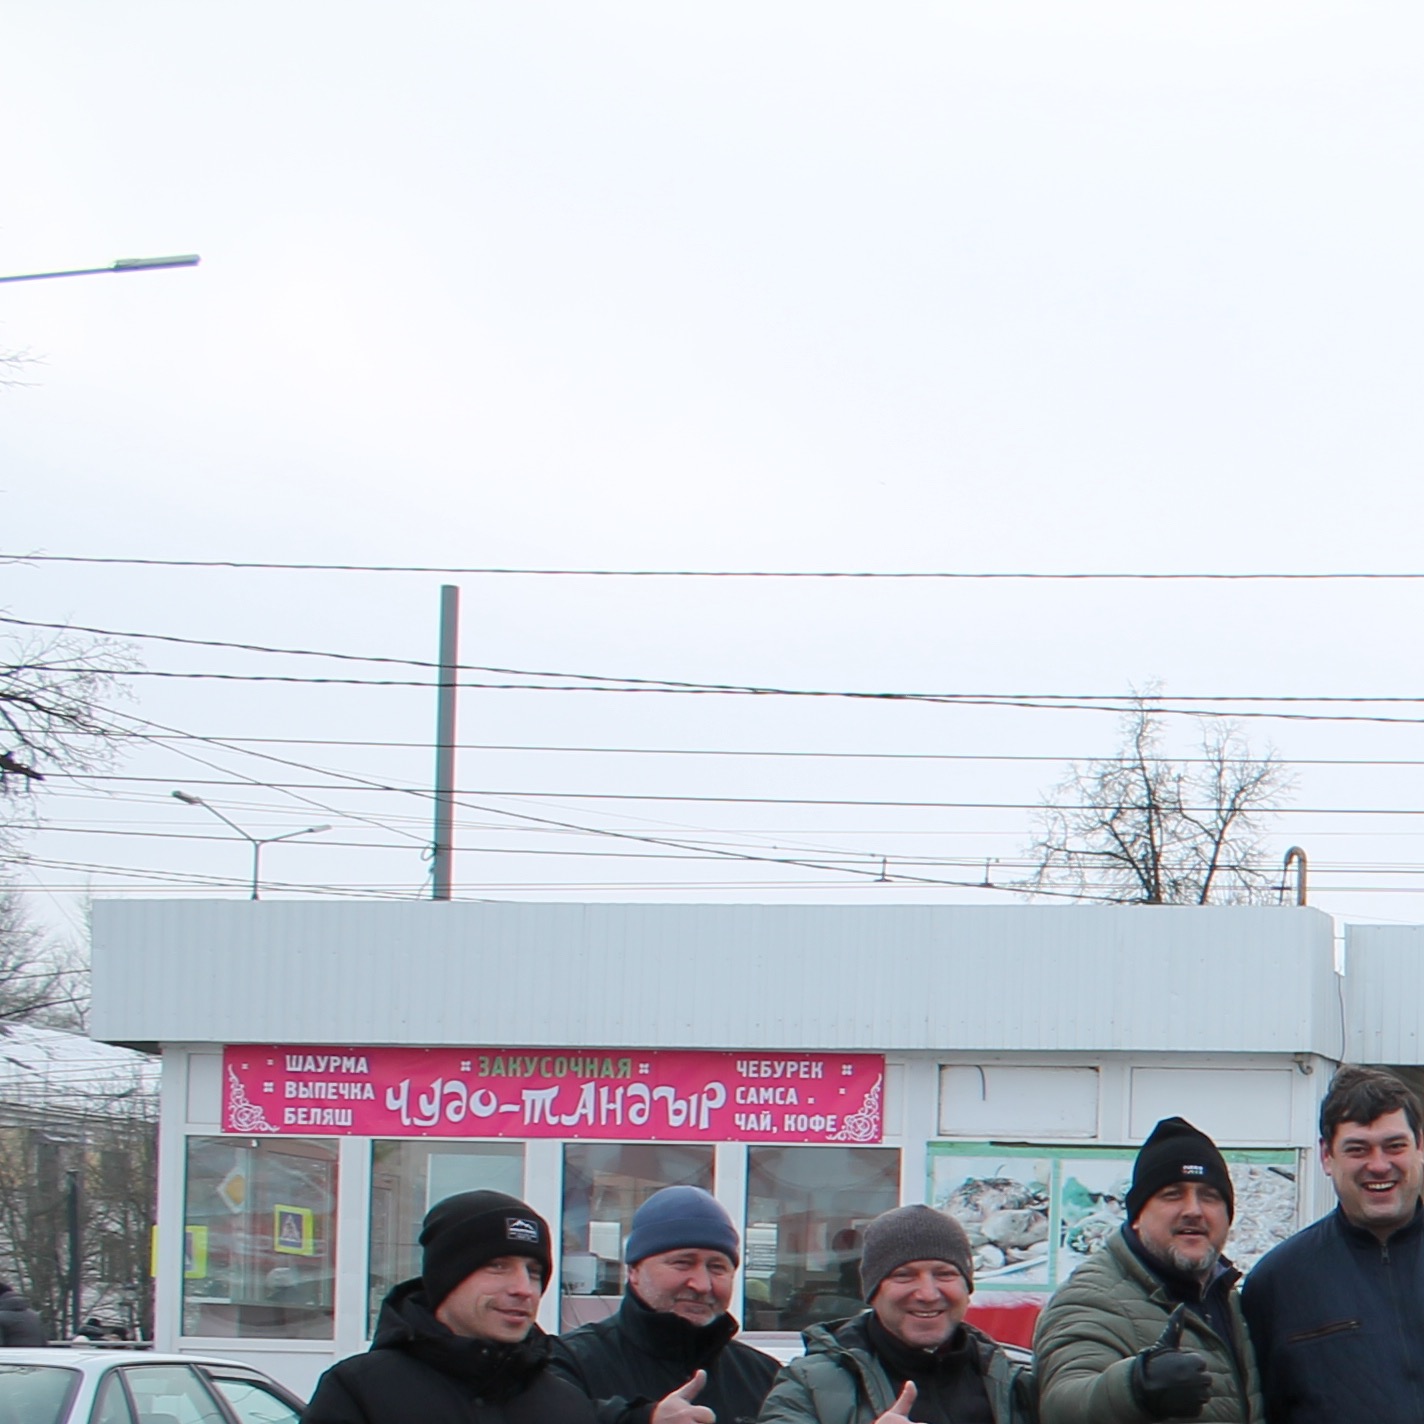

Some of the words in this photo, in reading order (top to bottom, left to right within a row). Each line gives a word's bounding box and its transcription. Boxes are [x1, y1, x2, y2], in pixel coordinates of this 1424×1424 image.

[285, 1054, 369, 1074] ШАУРМА
[478, 1055, 632, 1079] ЗАКУСОЧНАЯ
[736, 1060, 824, 1079] ЧЕБУРЕК
[284, 1081, 375, 1100] ВЫПЕЧКА
[735, 1086, 799, 1105] САМСА
[283, 1106, 353, 1126] БЕЛЯШ
[734, 1111, 779, 1134] ЧАЙ,
[783, 1113, 838, 1133] КОФЕ
